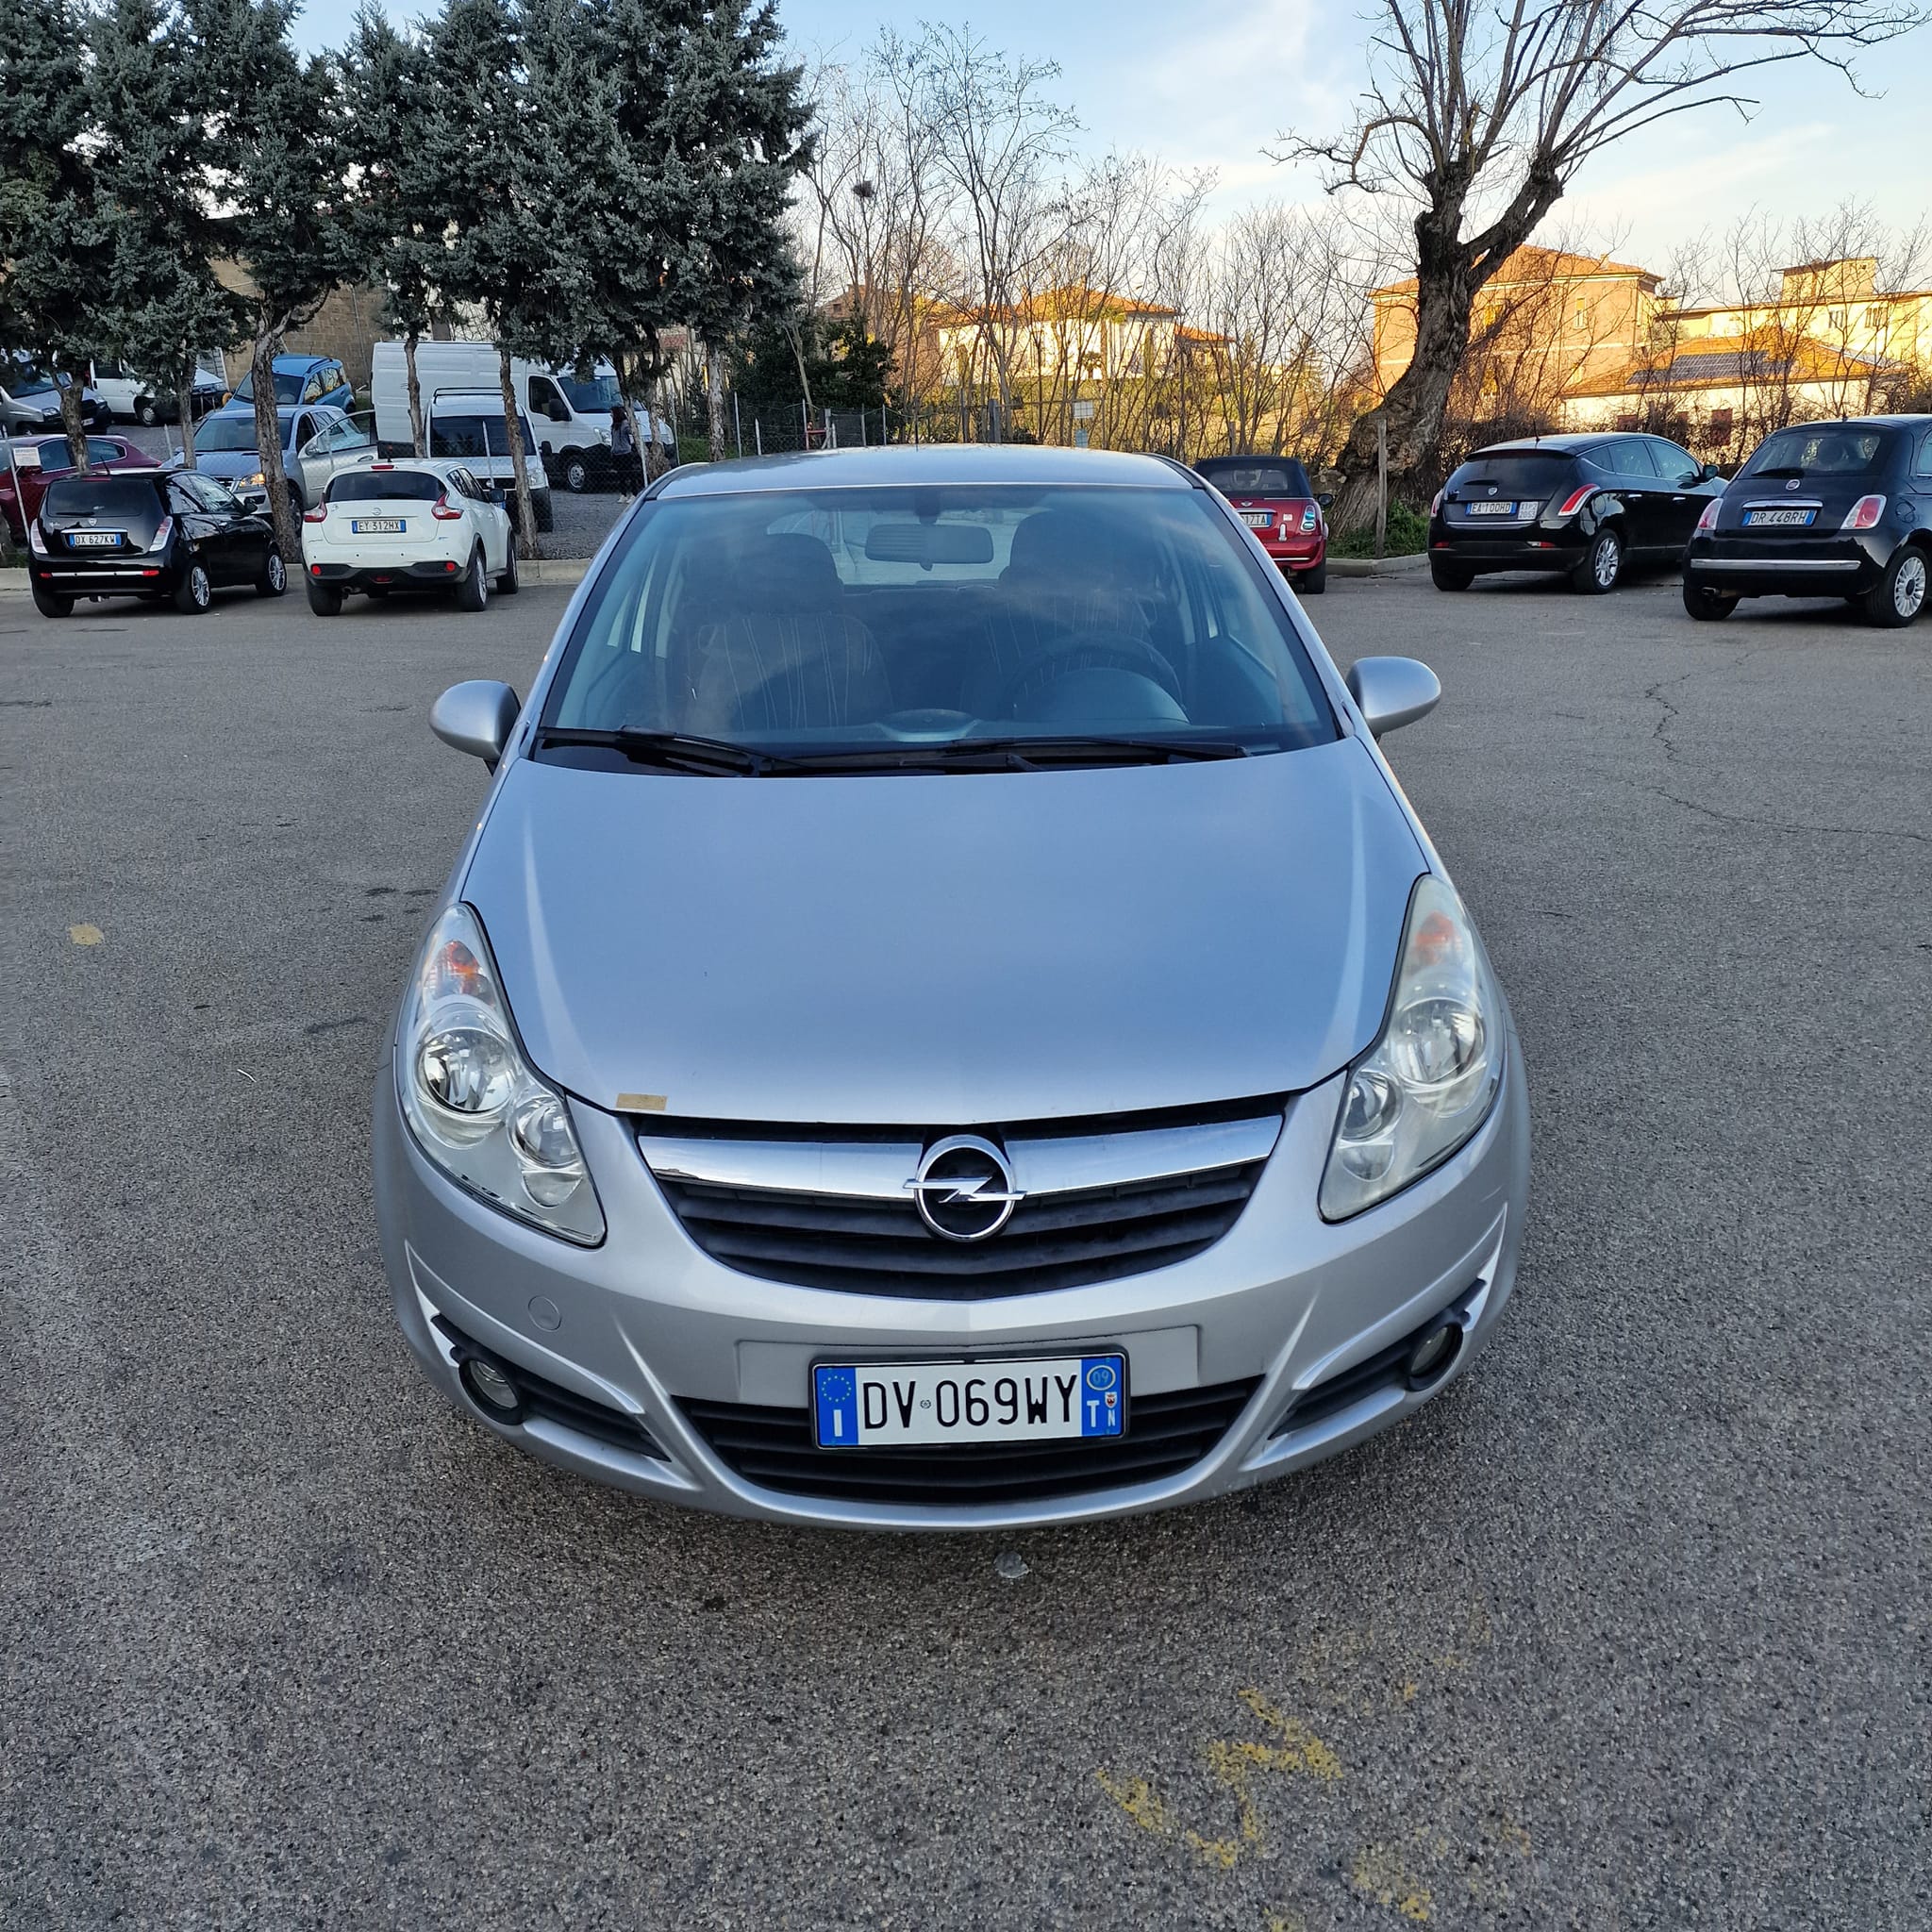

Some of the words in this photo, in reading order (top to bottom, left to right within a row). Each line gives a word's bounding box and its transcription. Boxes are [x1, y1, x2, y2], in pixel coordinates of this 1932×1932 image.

[1751, 513, 1767, 524] DR
[1769, 511, 1807, 524] 448RH
[358, 522, 369, 530] EY
[373, 521, 399, 530] 312HX
[89, 535, 115, 544] 627KW
[863, 1380, 917, 1429] DV
[936, 1374, 1077, 1427] 069WY
